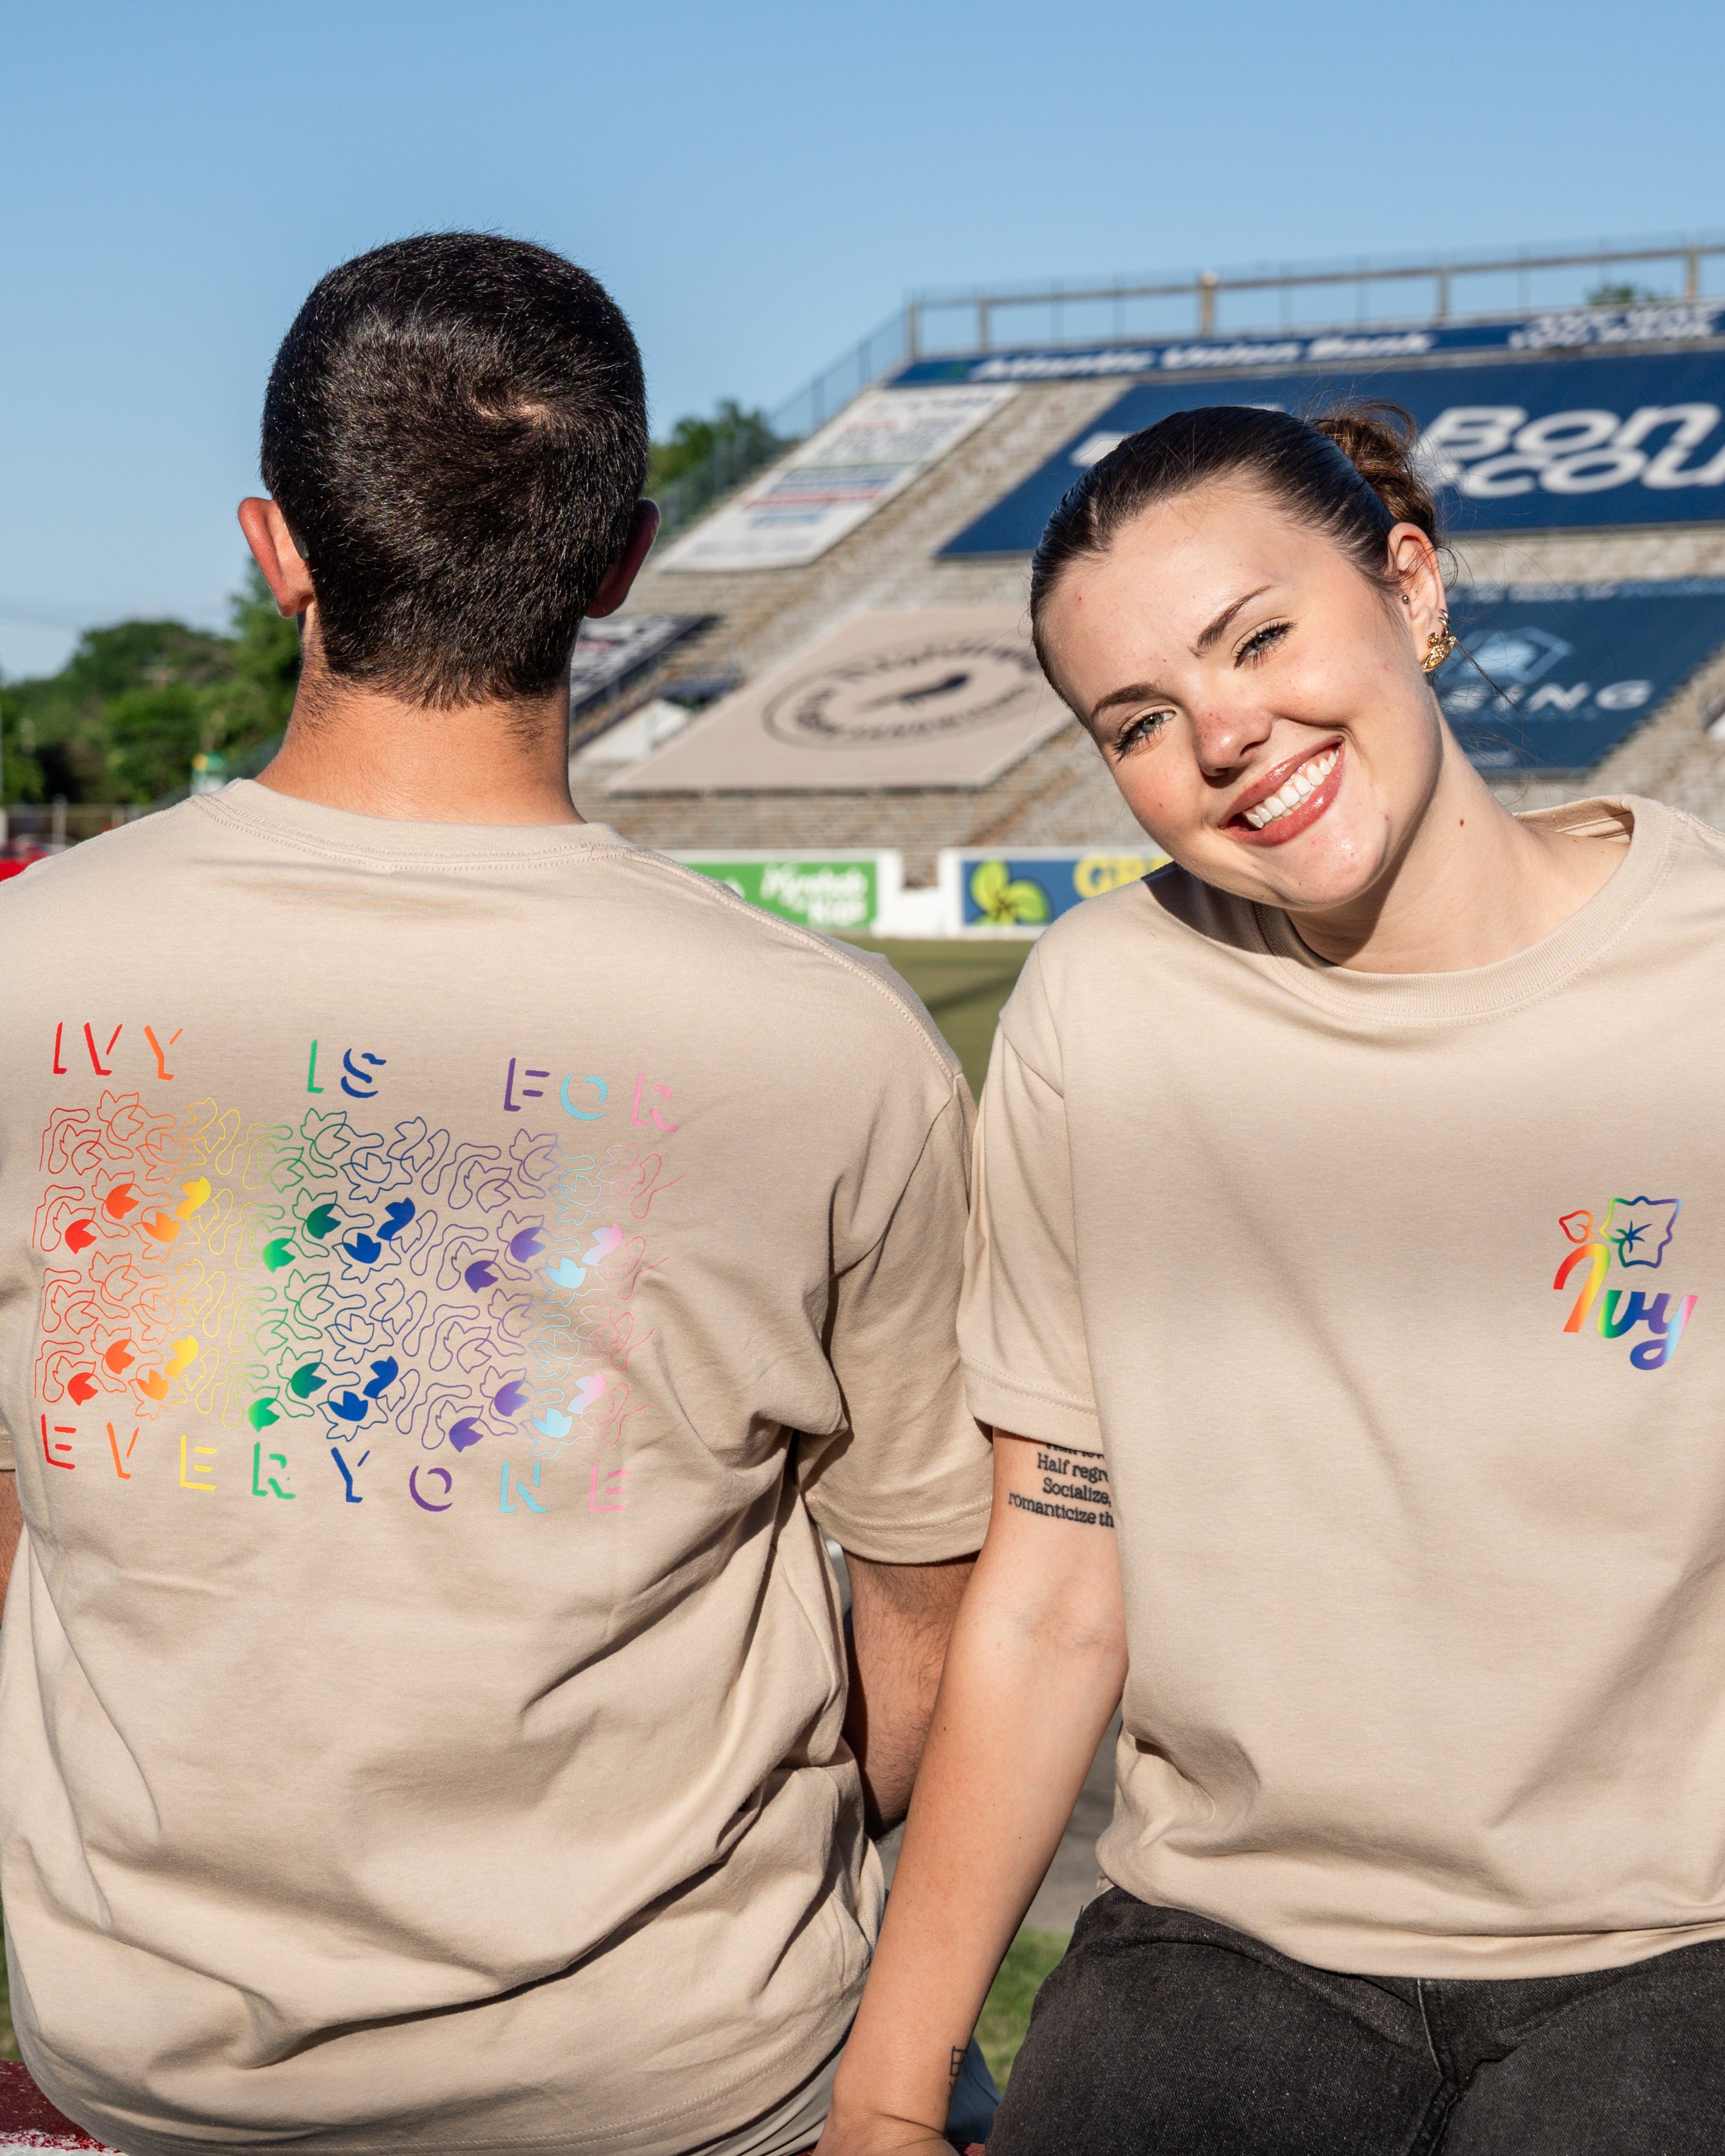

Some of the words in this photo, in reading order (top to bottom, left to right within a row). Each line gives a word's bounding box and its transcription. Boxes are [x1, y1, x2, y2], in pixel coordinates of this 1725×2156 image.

[52, 1021, 183, 1081] IVY
[306, 1039, 387, 1099] IS
[503, 1057, 679, 1132] FOR
[40, 1413, 631, 1513] EVERYONE
[1037, 1451, 1070, 1475] Half
[1008, 1492, 1097, 1525] romanticize
[1043, 1477, 1112, 1508] Socialize,
